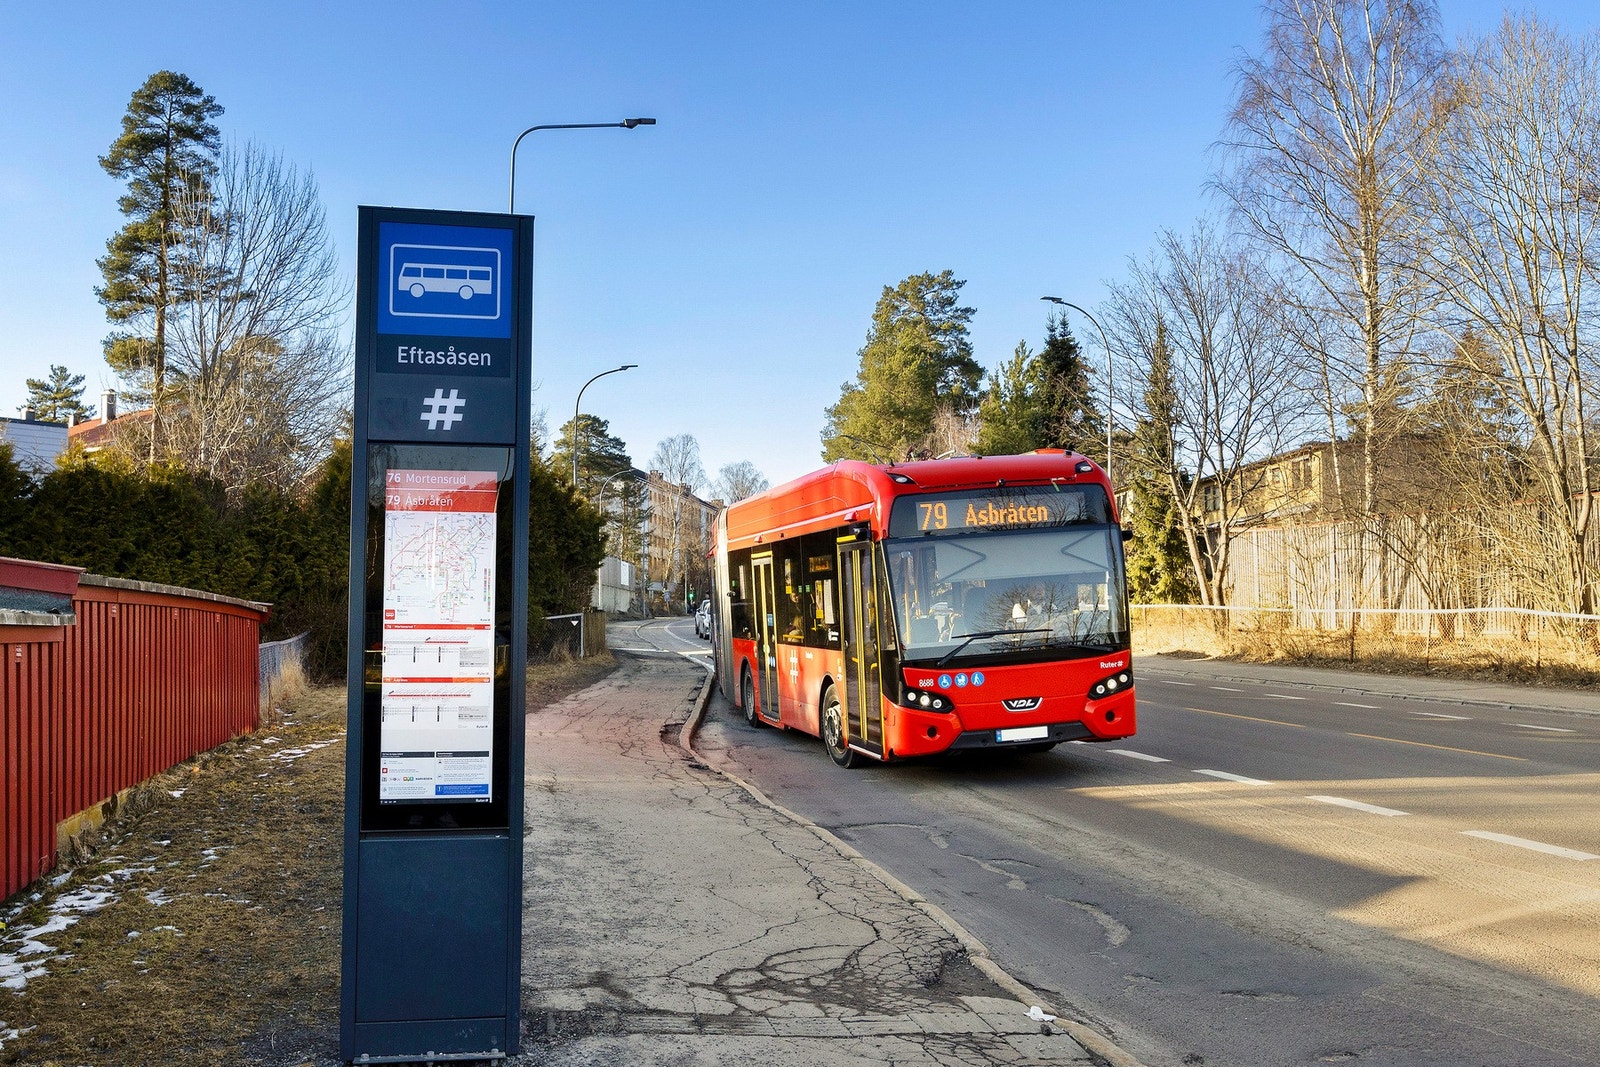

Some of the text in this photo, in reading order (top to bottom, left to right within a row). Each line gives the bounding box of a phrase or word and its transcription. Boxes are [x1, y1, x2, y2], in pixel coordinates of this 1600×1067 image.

[398, 346, 491, 366] Eftasåsen
[387, 472, 467, 485] 76 Mortensrud
[387, 493, 453, 507] 79 Åsbråten
[919, 502, 1048, 531] 79 Åsbråten
[1100, 660, 1124, 669] Ruter#
[1008, 698, 1036, 708] VDL
